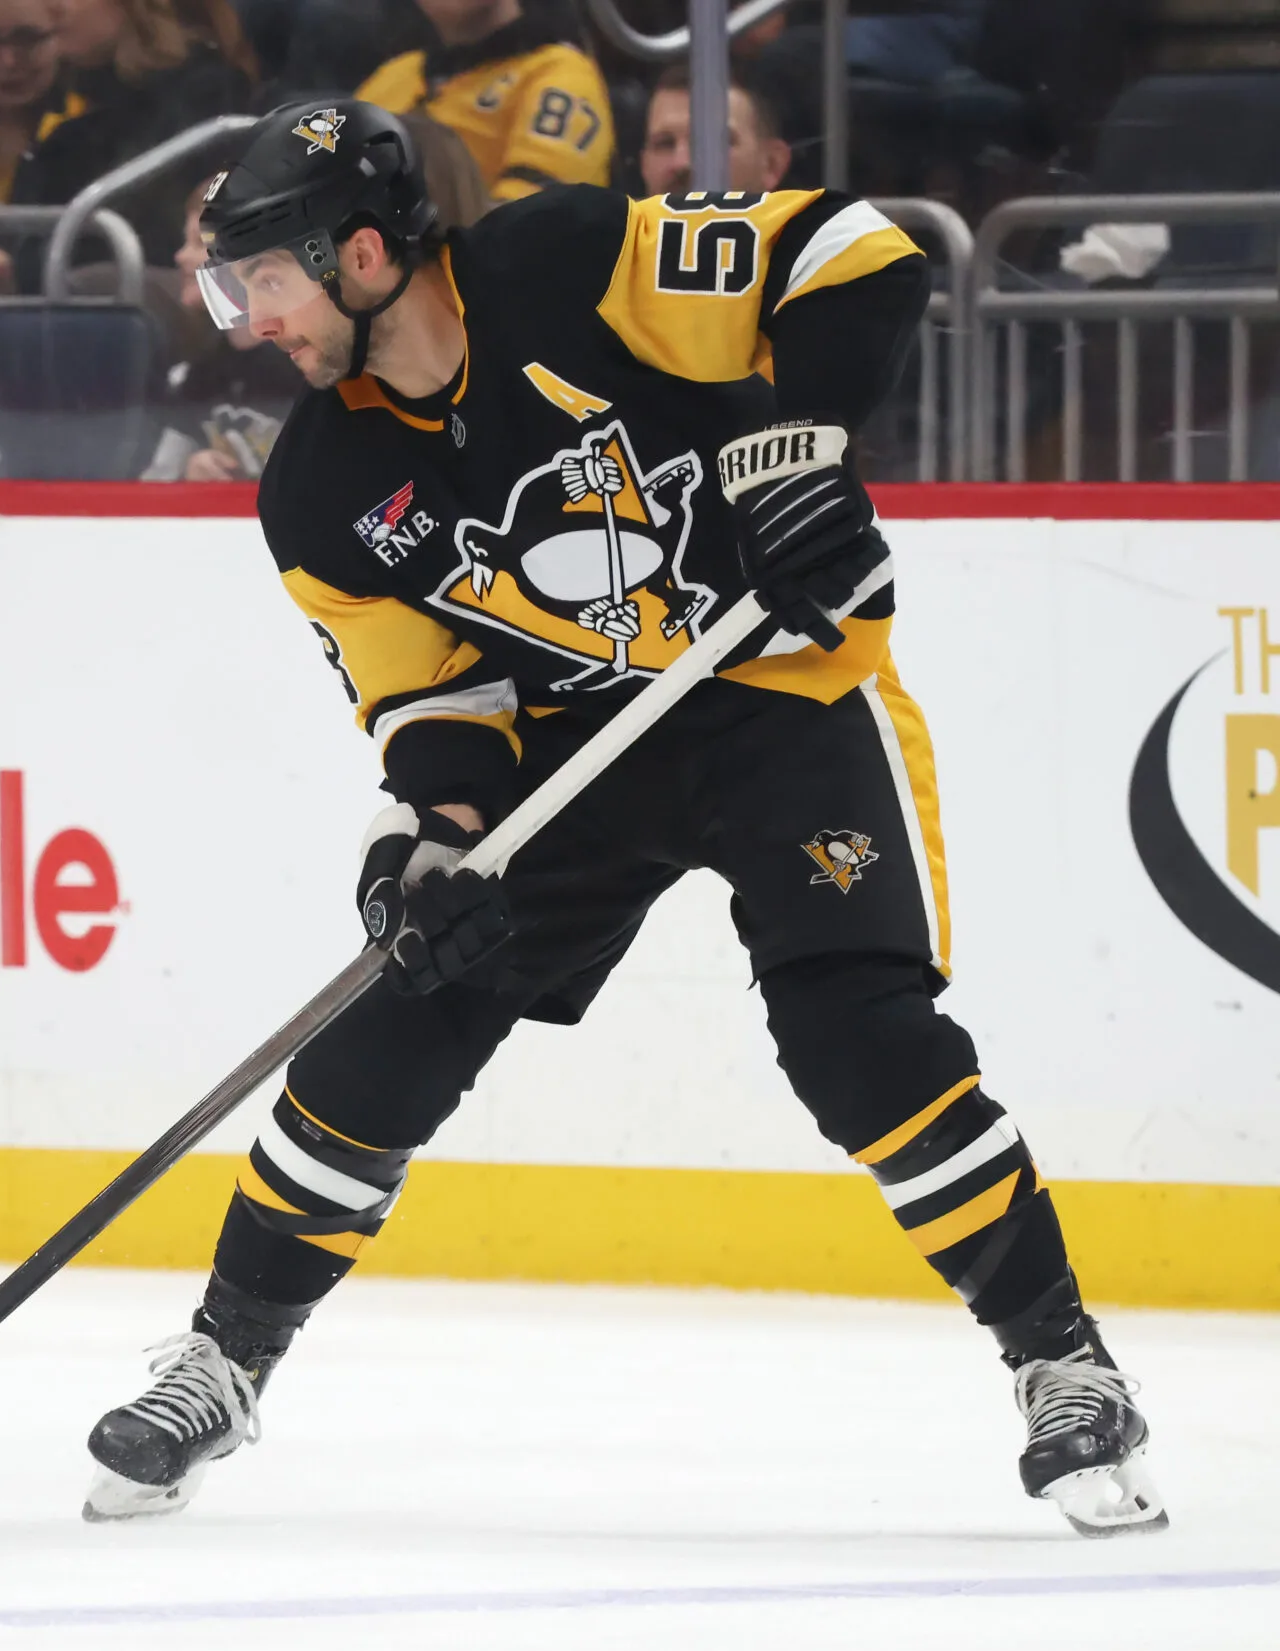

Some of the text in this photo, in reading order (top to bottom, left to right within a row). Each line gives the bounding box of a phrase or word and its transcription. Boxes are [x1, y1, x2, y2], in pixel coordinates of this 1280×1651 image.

[529, 87, 602, 155] 87
[522, 362, 613, 423] A
[373, 510, 440, 567] F.N.B.
